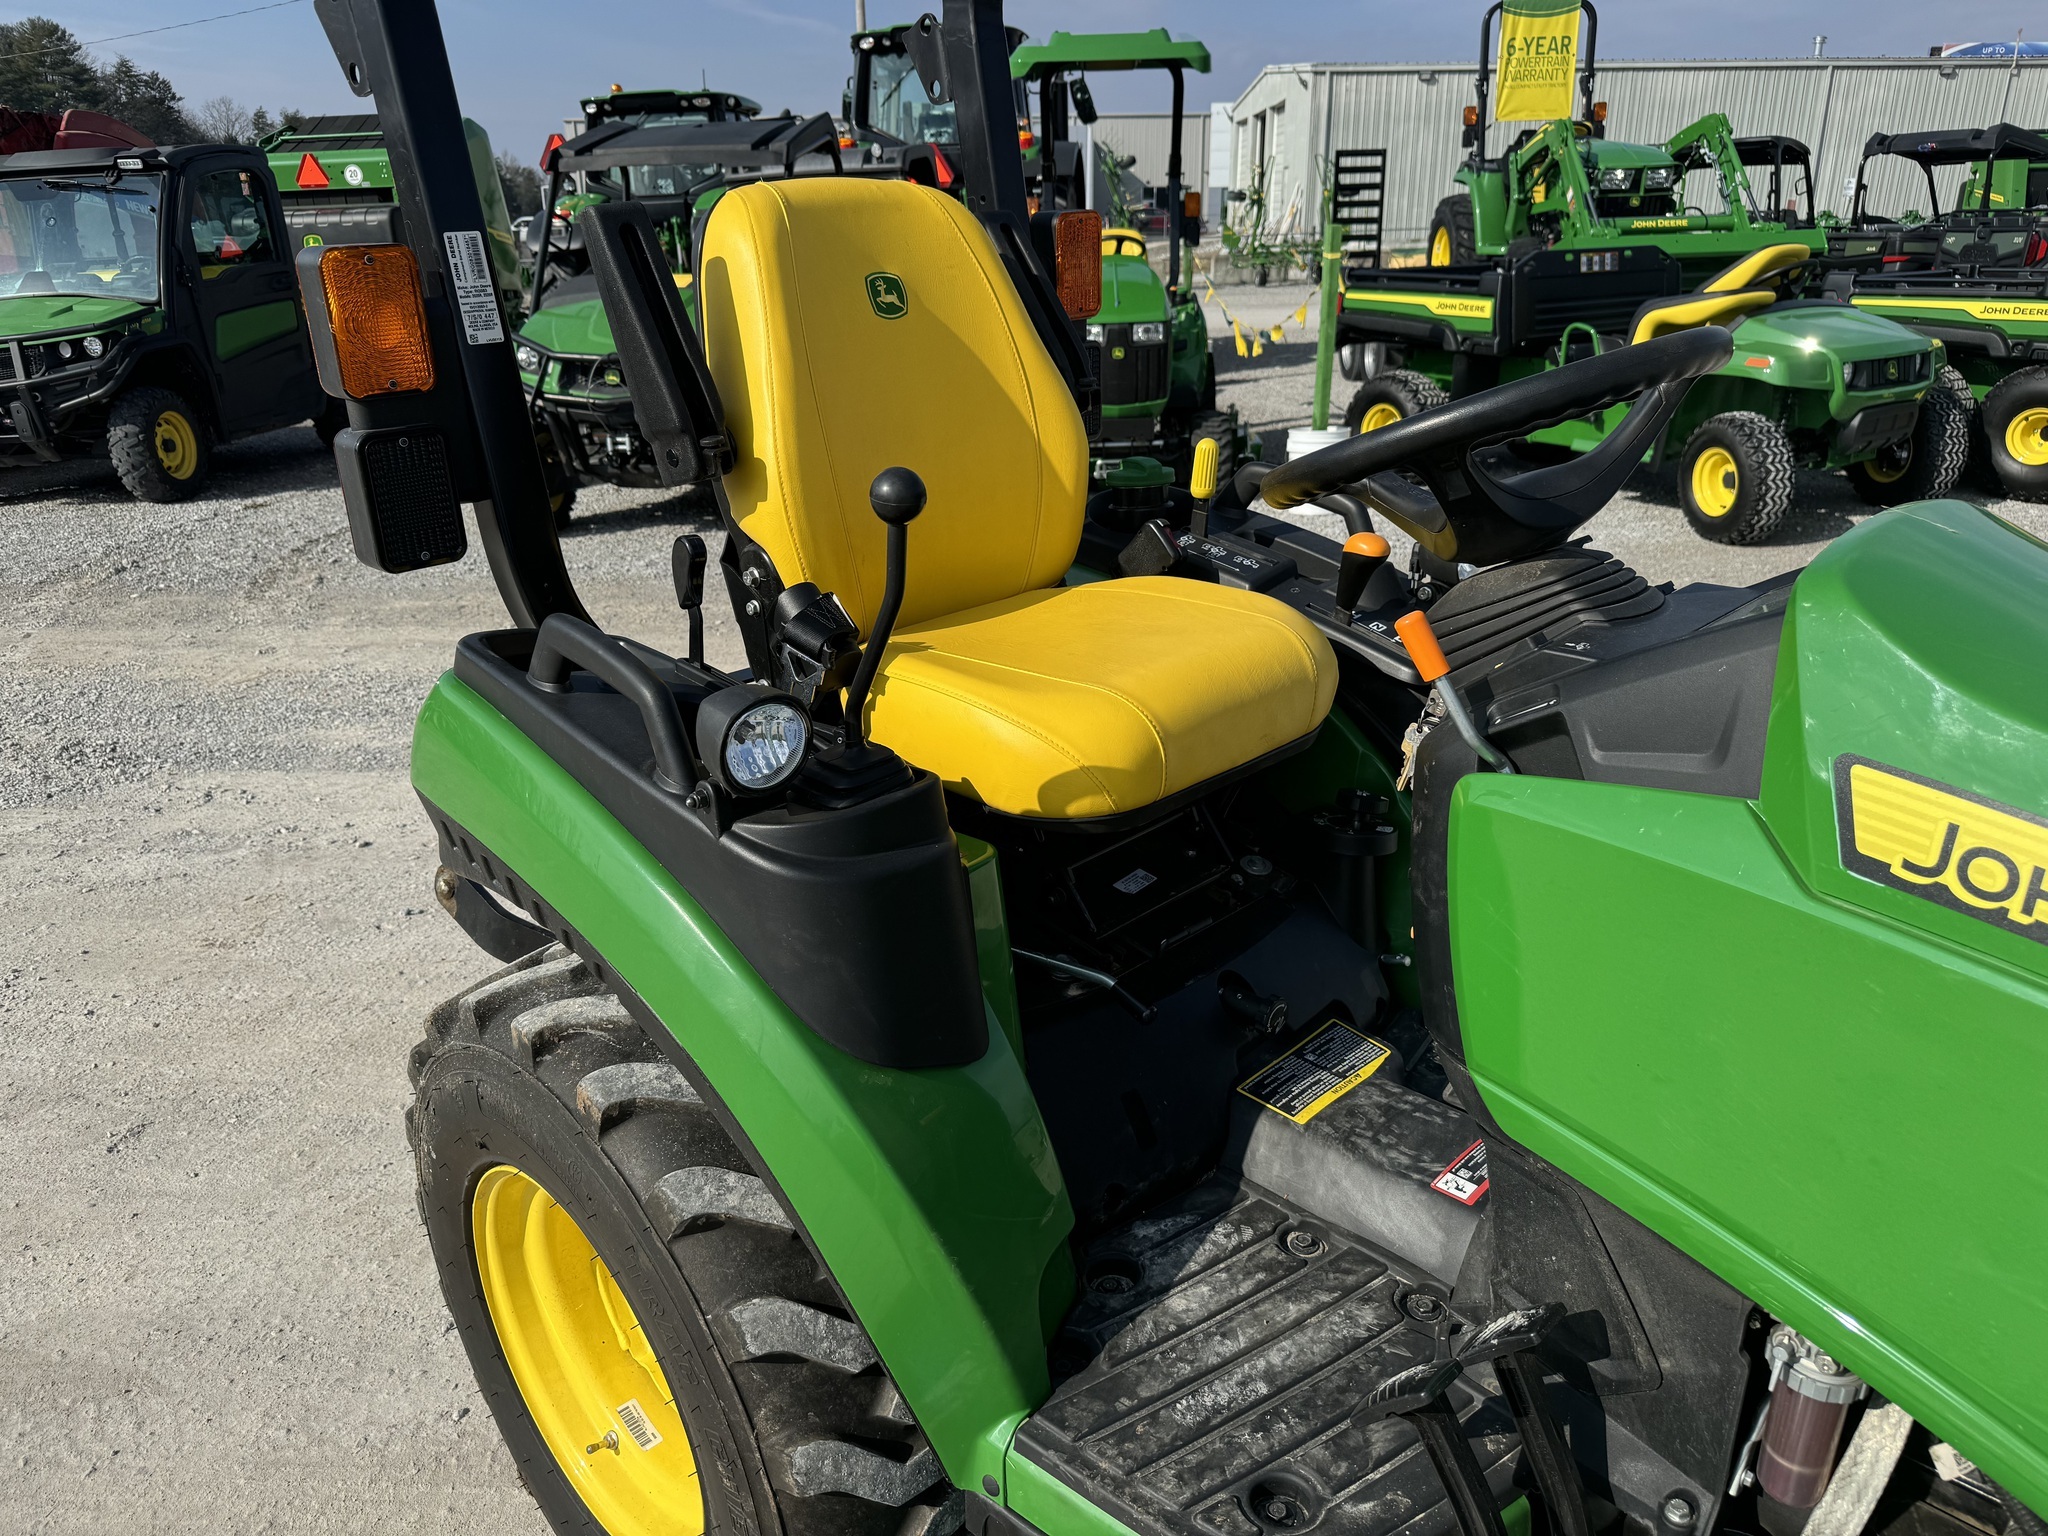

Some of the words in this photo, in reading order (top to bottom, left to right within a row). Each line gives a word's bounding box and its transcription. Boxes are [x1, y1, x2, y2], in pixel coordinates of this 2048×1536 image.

[1506, 35, 1572, 56] 6-YEAR
[1506, 56, 1570, 69] POWERTRAIN
[1505, 68, 1569, 82] WARRANTY
[348, 170, 358, 178] 20
[125, 199, 150, 214] NEW
[1631, 220, 1656, 228] JOHN
[1658, 218, 1688, 228] DEERE
[447, 235, 456, 258] DEERE
[453, 263, 462, 282] JOHN
[1436, 302, 1457, 311] JOHN
[1458, 302, 1486, 313] DEERE
[1980, 306, 2010, 314] JOHN
[1330, 1074, 1358, 1094] CAUTION
